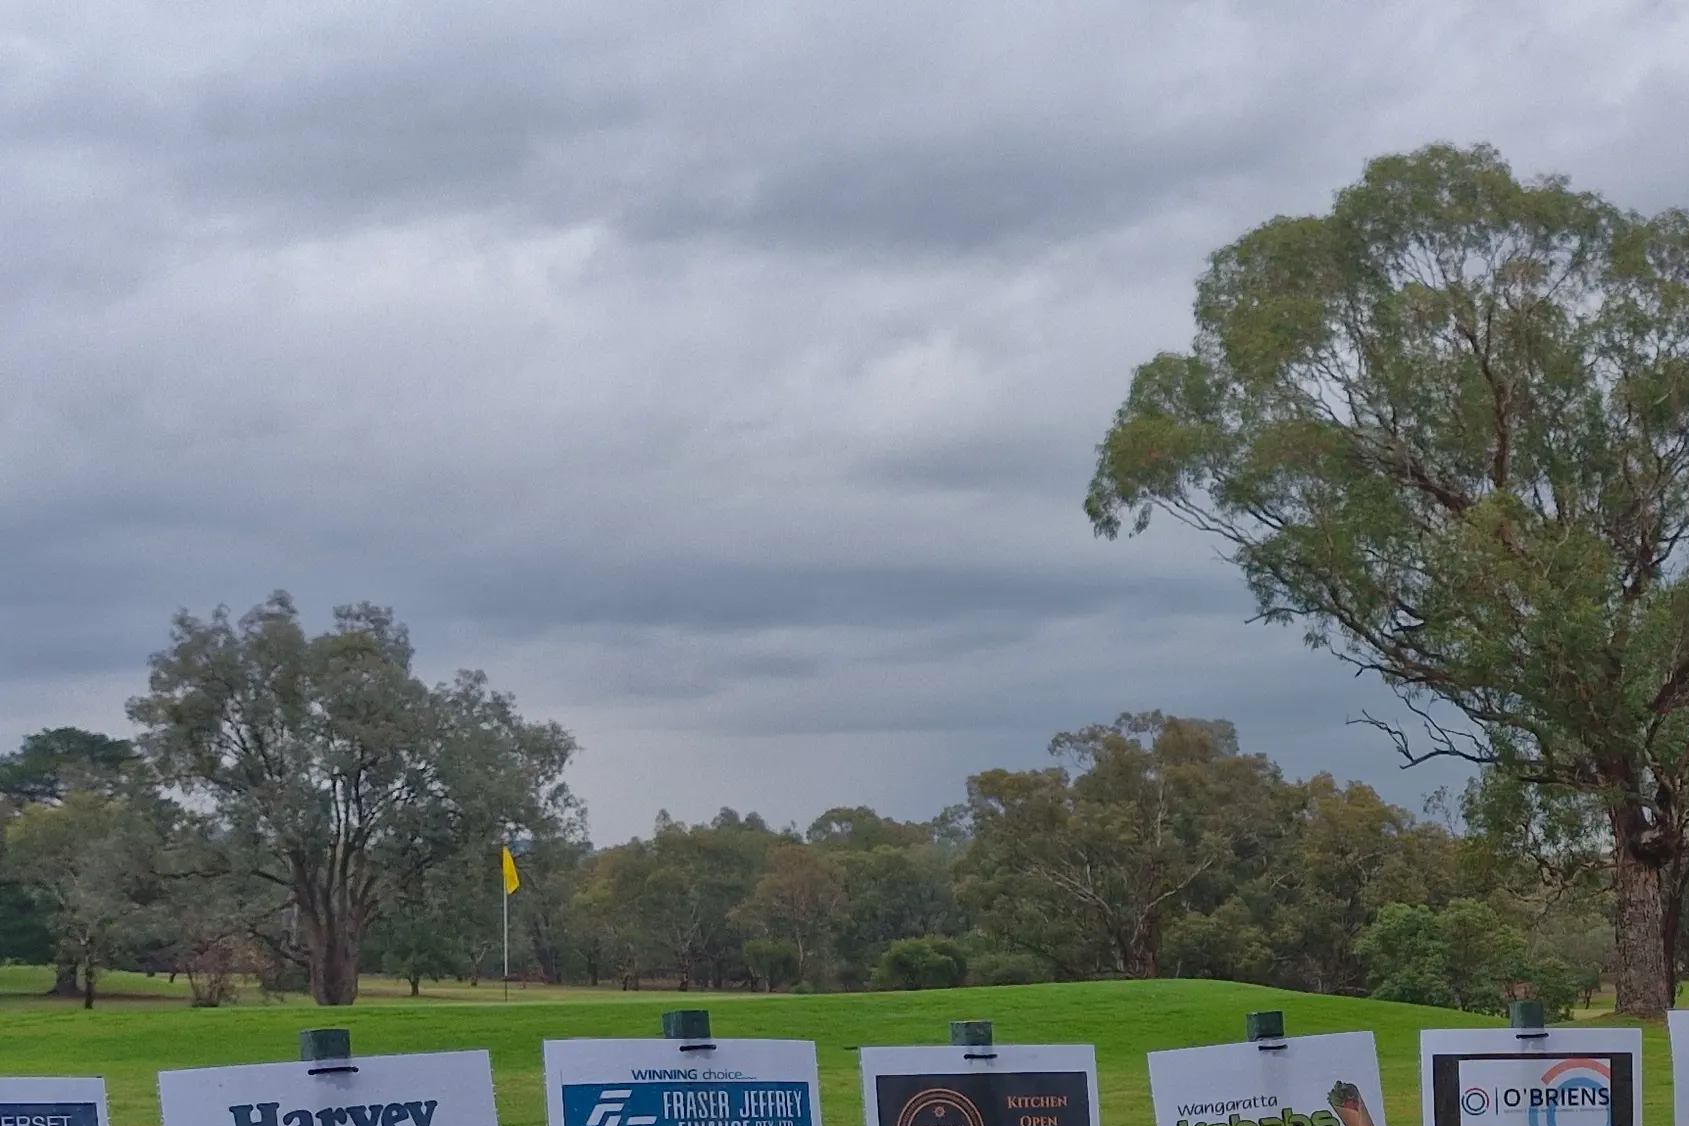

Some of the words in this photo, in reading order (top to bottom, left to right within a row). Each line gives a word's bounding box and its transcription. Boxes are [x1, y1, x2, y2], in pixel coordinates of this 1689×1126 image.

[631, 1069, 698, 1081] WINNING
[662, 1090, 730, 1120] FRASER
[739, 1089, 803, 1119] JEFFREY
[1007, 1096, 1068, 1109] KITCHEN
[1177, 1094, 1278, 1117] Wangaratta
[1503, 1088, 1610, 1107] O'BRIENS
